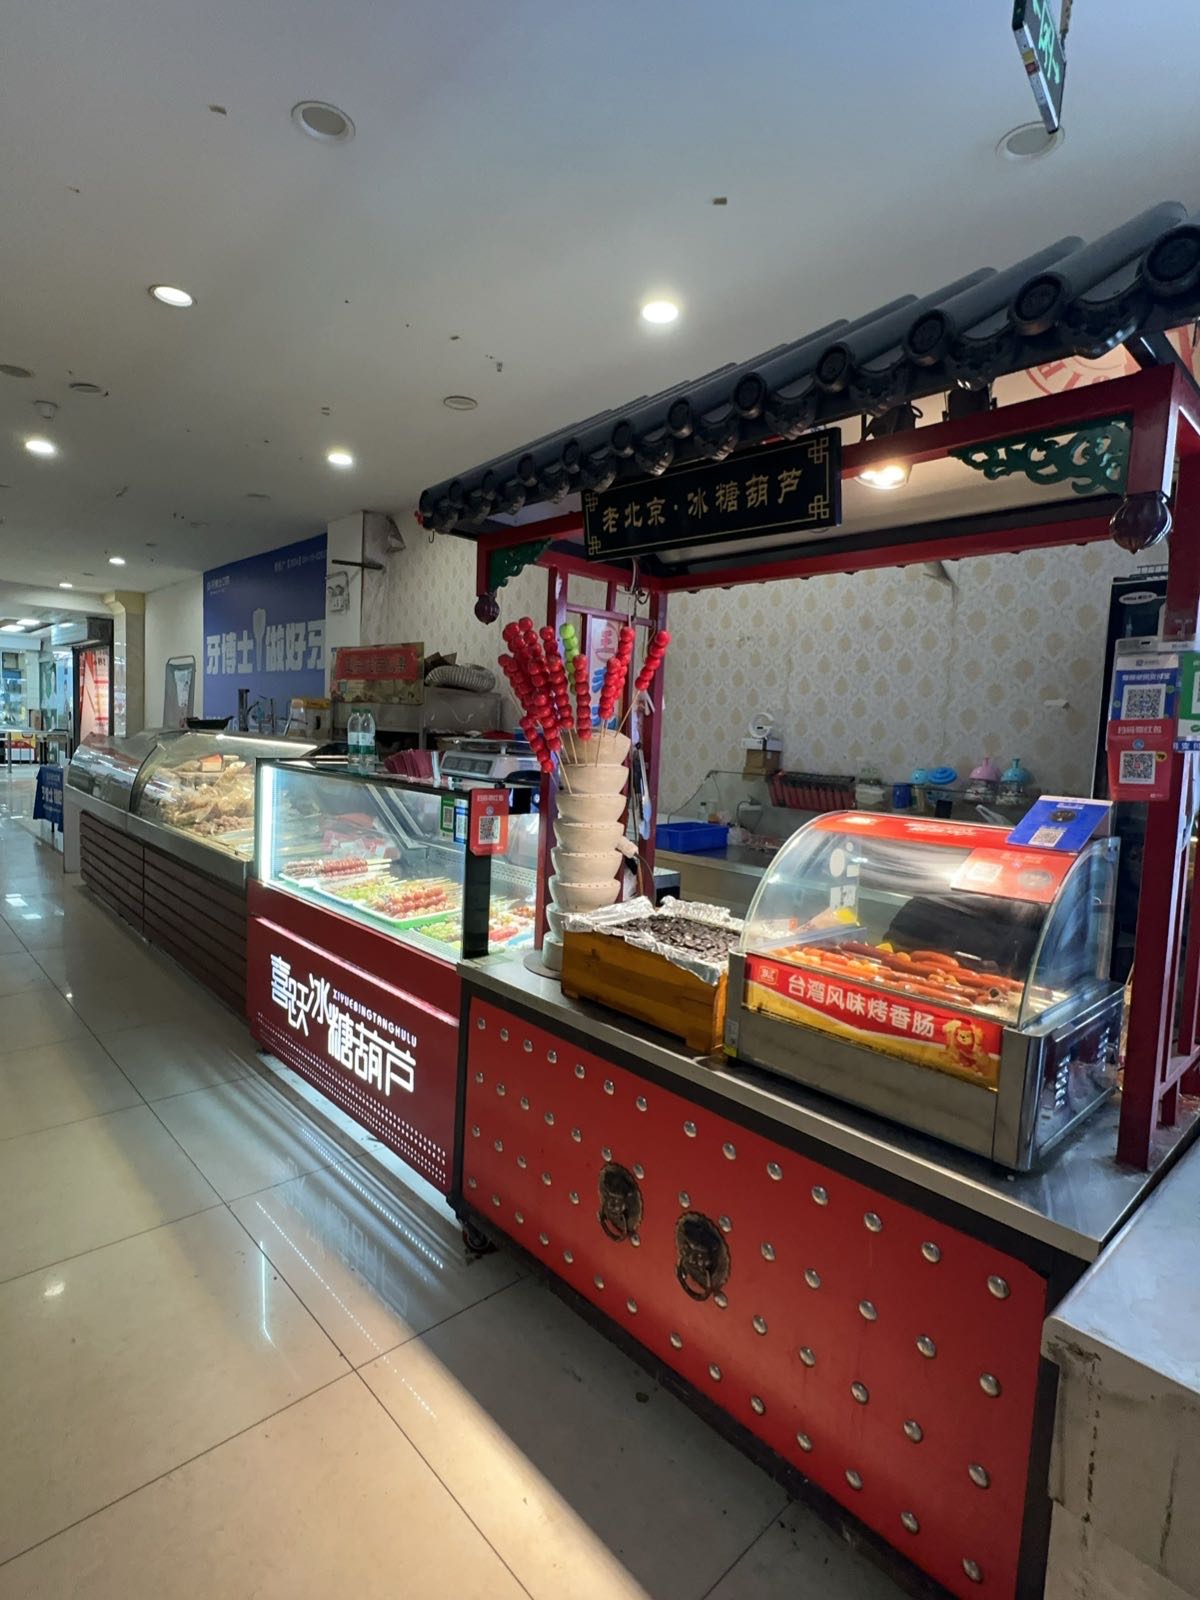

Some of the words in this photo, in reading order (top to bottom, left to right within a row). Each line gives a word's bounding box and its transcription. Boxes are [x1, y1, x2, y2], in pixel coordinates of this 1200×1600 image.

[603, 467, 802, 534] 老北京·冰糖葫芦
[206, 630, 254, 675] 牙博士
[332, 988, 418, 1048] XIYUEBINGTANGHULU
[787, 974, 935, 1038] 台湾风味烤香肠
